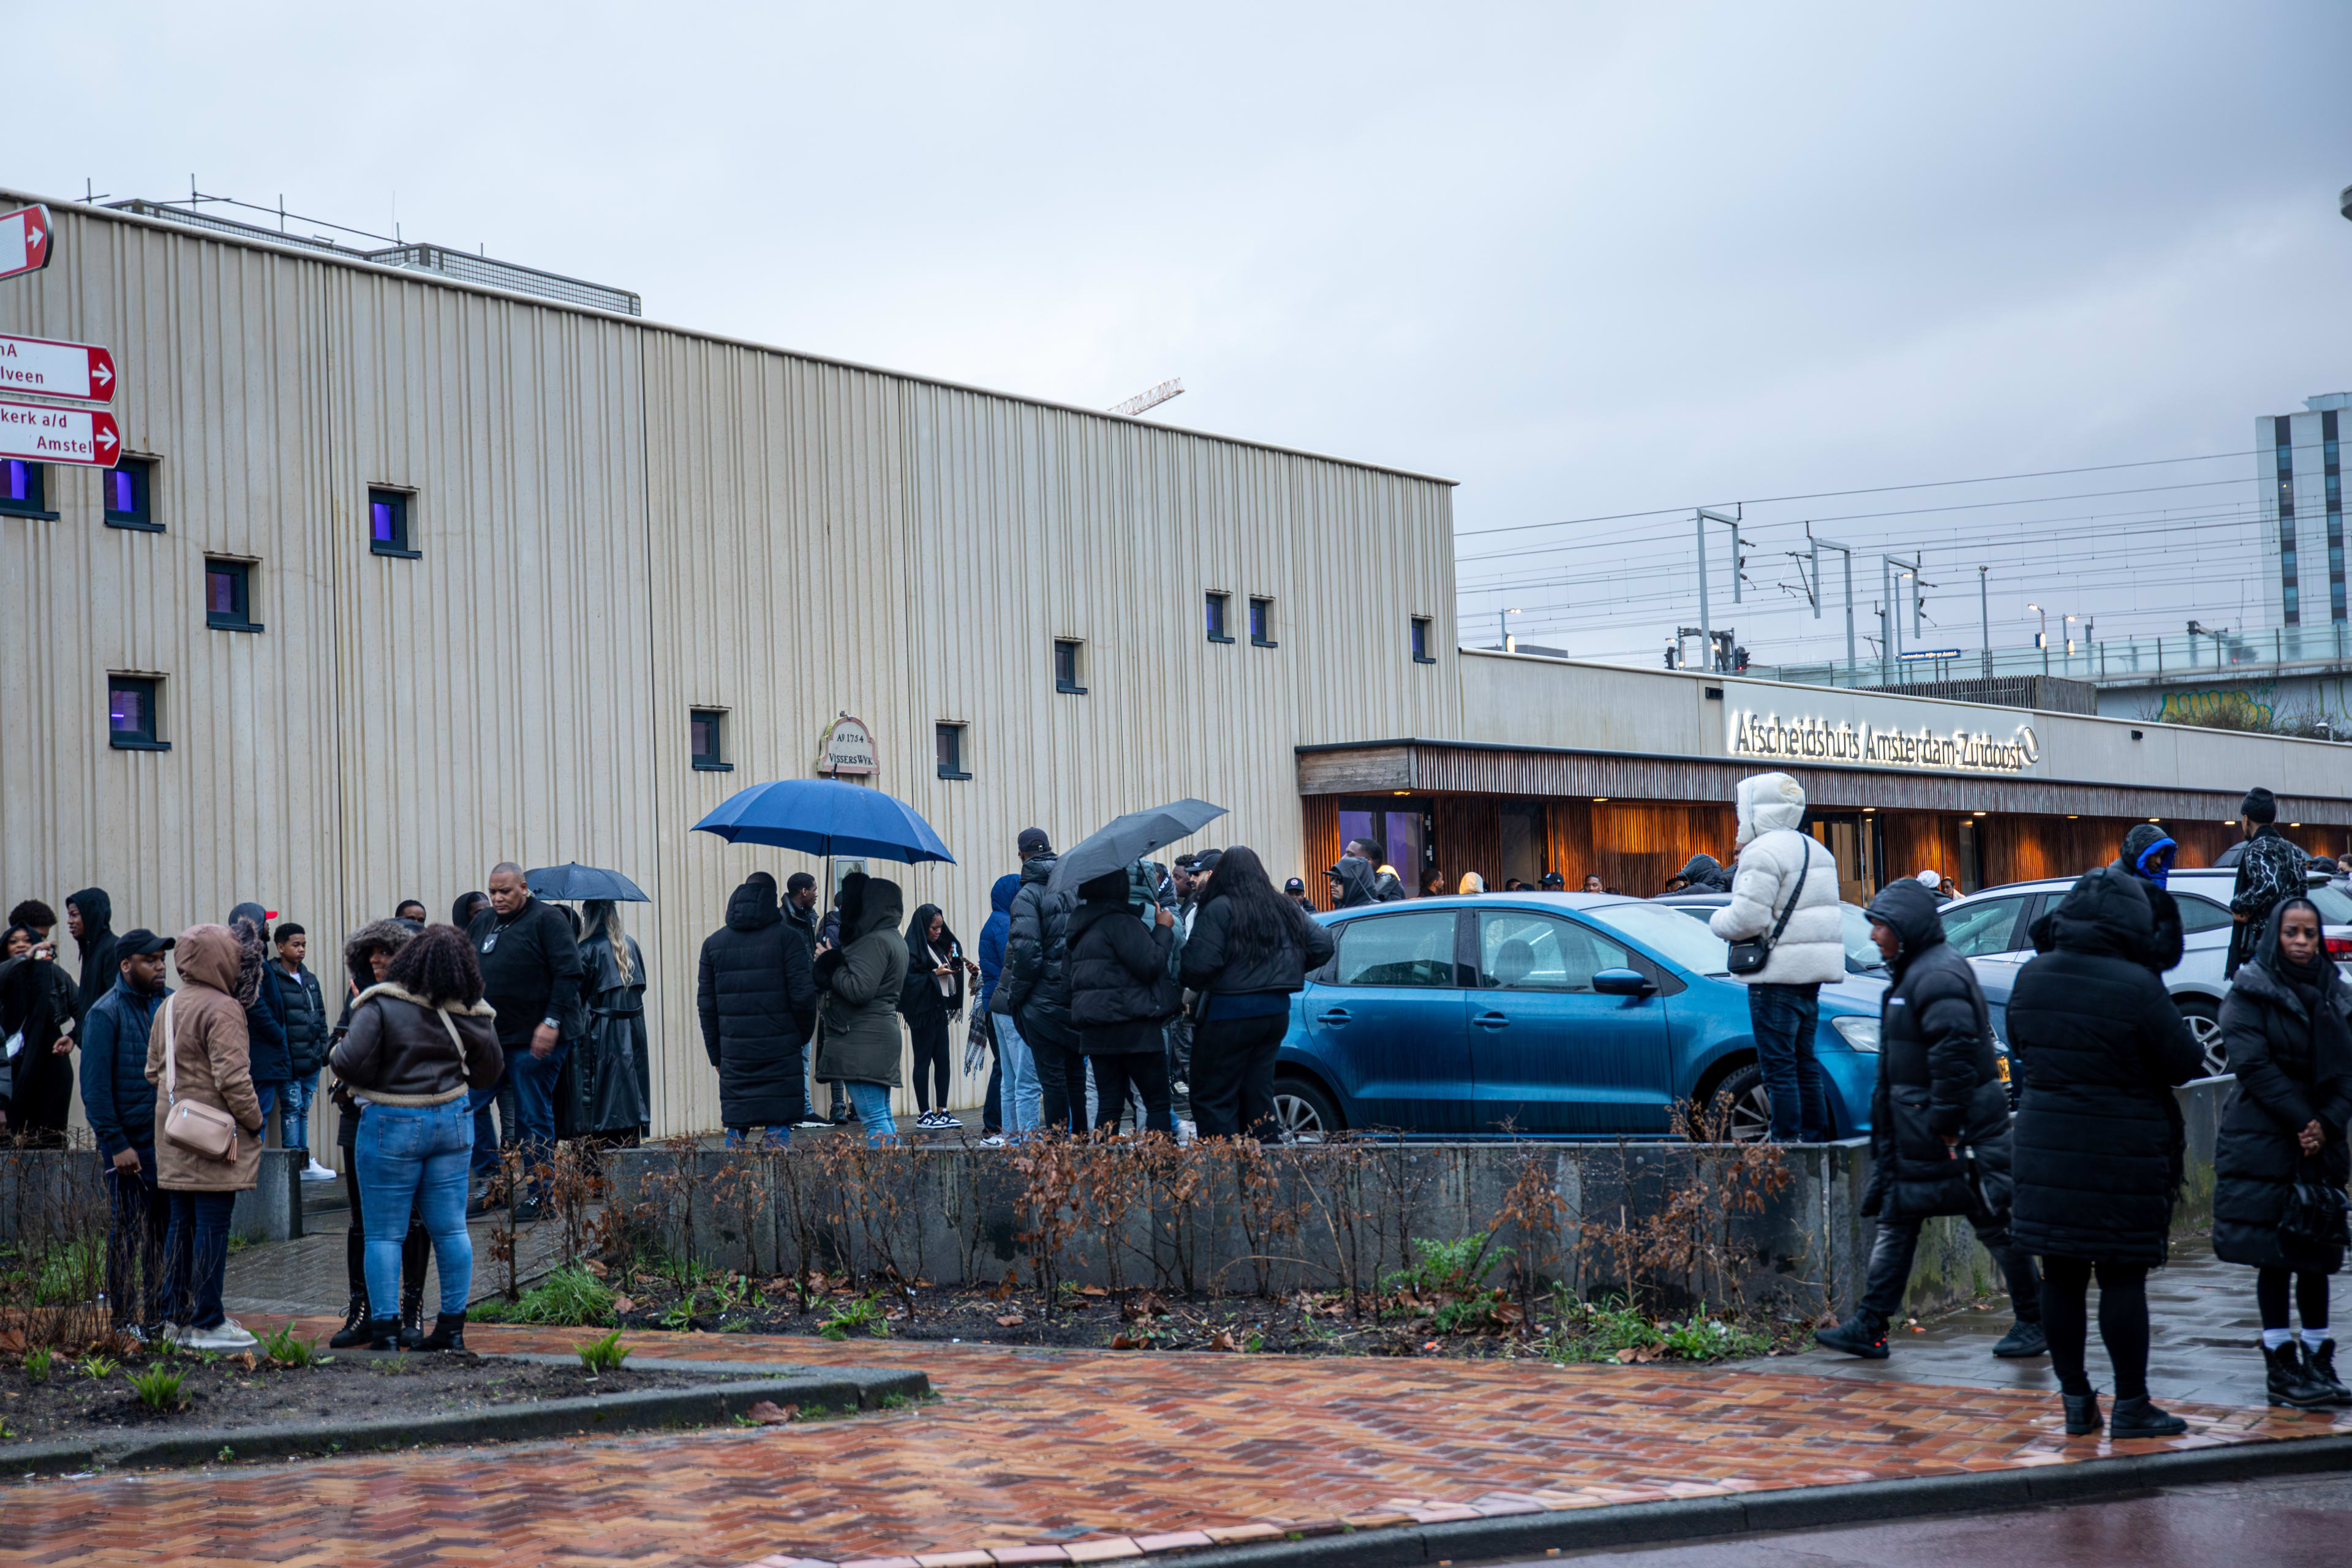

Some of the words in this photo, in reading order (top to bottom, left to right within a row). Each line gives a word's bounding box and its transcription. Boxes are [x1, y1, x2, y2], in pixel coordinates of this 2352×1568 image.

[1, 366, 44, 384] lveen
[1, 408, 37, 425] kerk
[42, 413, 67, 428] a/d
[37, 435, 92, 454] Amstel
[847, 734, 864, 743] 1754
[1735, 713, 1860, 760] Afscheidshuis
[1864, 725, 2022, 770] Amsterdam-Zuidoost
